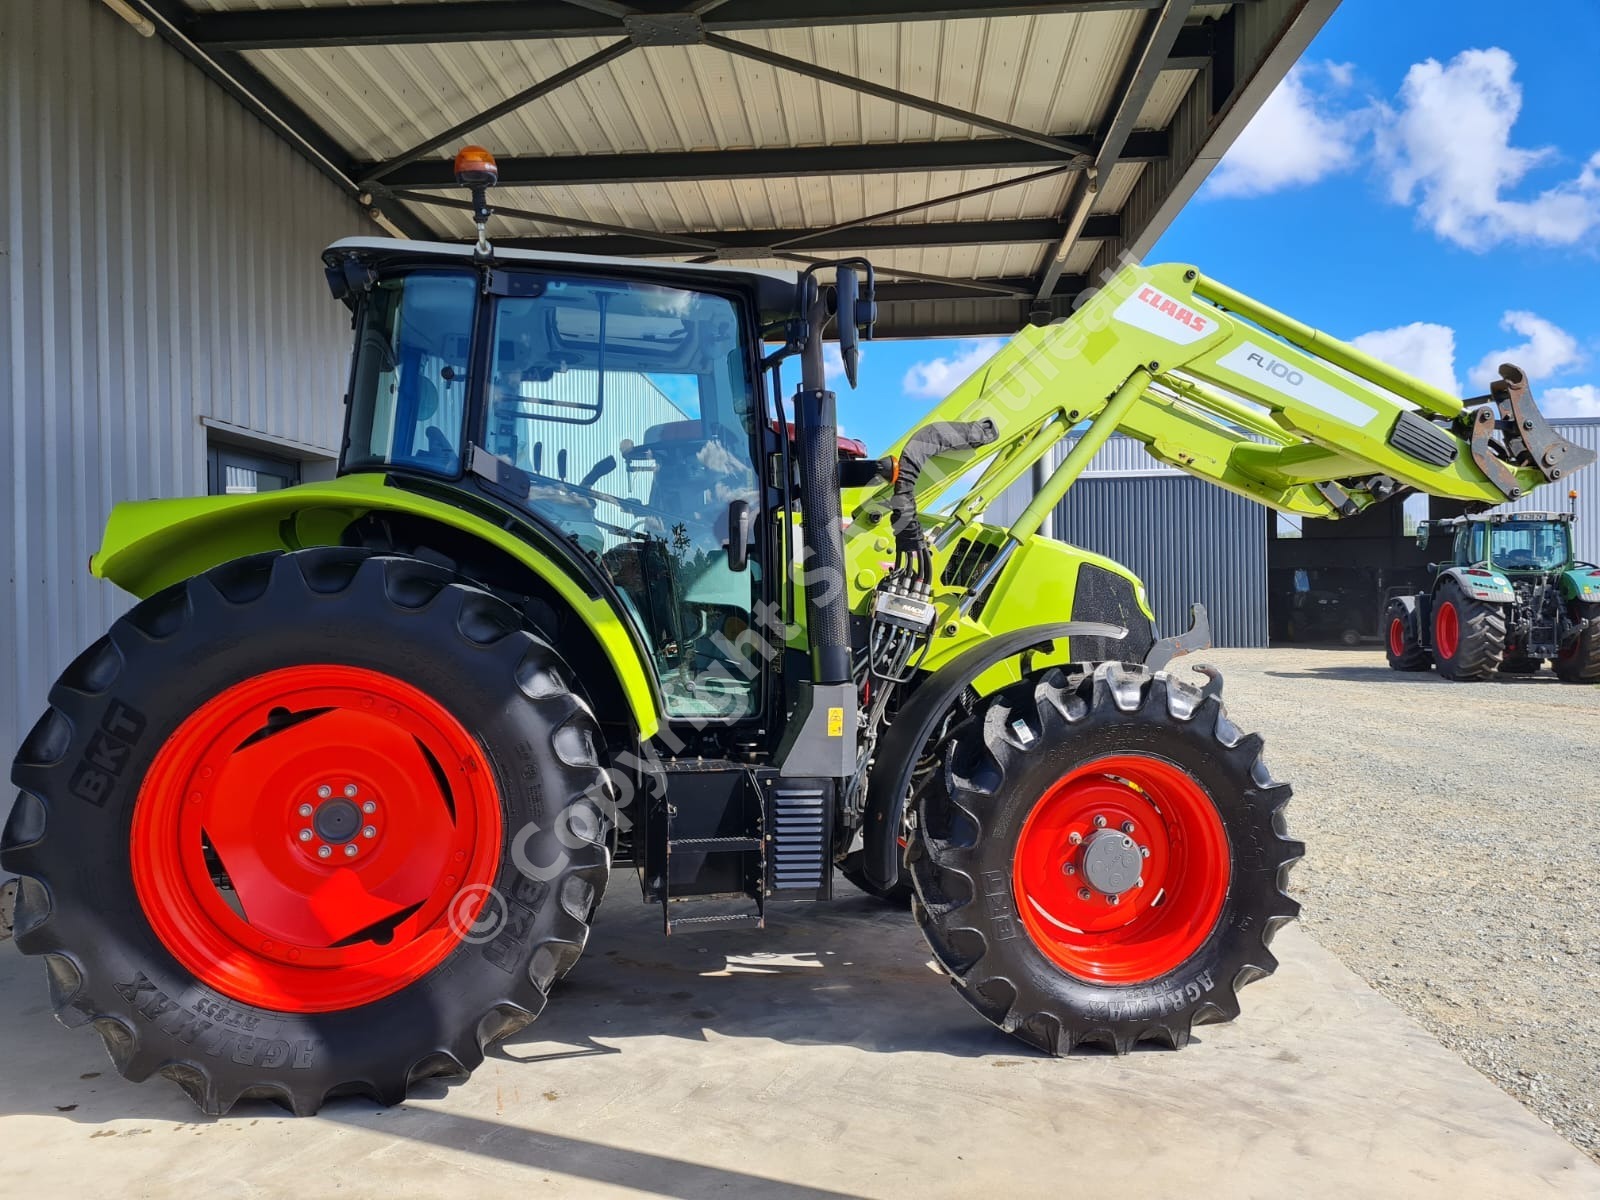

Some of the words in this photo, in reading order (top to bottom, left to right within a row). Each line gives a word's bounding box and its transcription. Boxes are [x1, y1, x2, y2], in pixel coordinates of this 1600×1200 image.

[1138, 288, 1207, 332] CLAAS
[72, 702, 142, 806] BKT
[1083, 968, 1216, 1022] AGRIMAX
